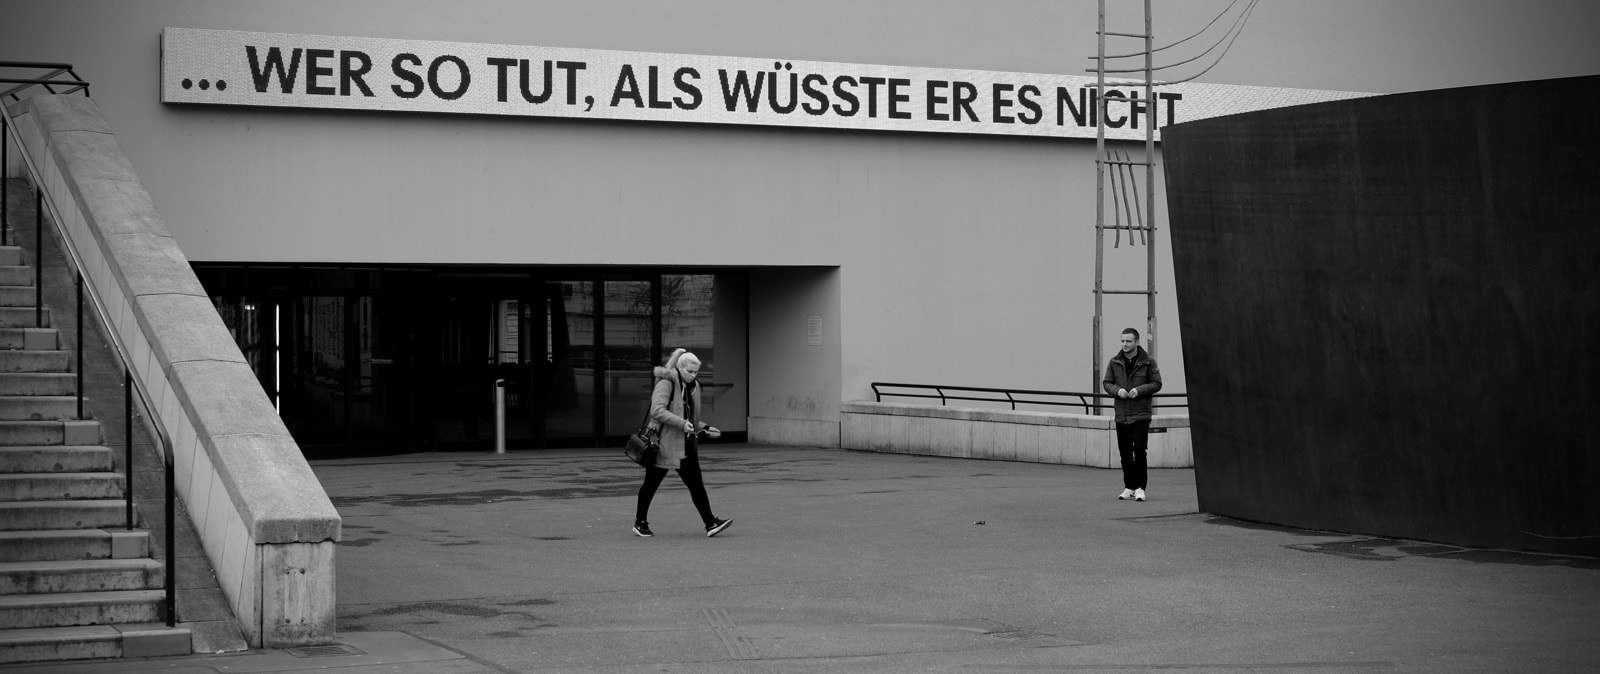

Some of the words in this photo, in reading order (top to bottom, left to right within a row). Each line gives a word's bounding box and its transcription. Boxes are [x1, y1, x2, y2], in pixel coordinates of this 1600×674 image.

[181, 78, 227, 92] ...
[245, 46, 374, 97] WER
[391, 53, 471, 101] SO
[487, 58, 595, 112] TUT,
[610, 65, 703, 111] ALS
[719, 62, 912, 120] WÜSSTE
[927, 80, 981, 122] ER
[993, 84, 1043, 125] ES
[1057, 86, 1183, 131] NICHT
